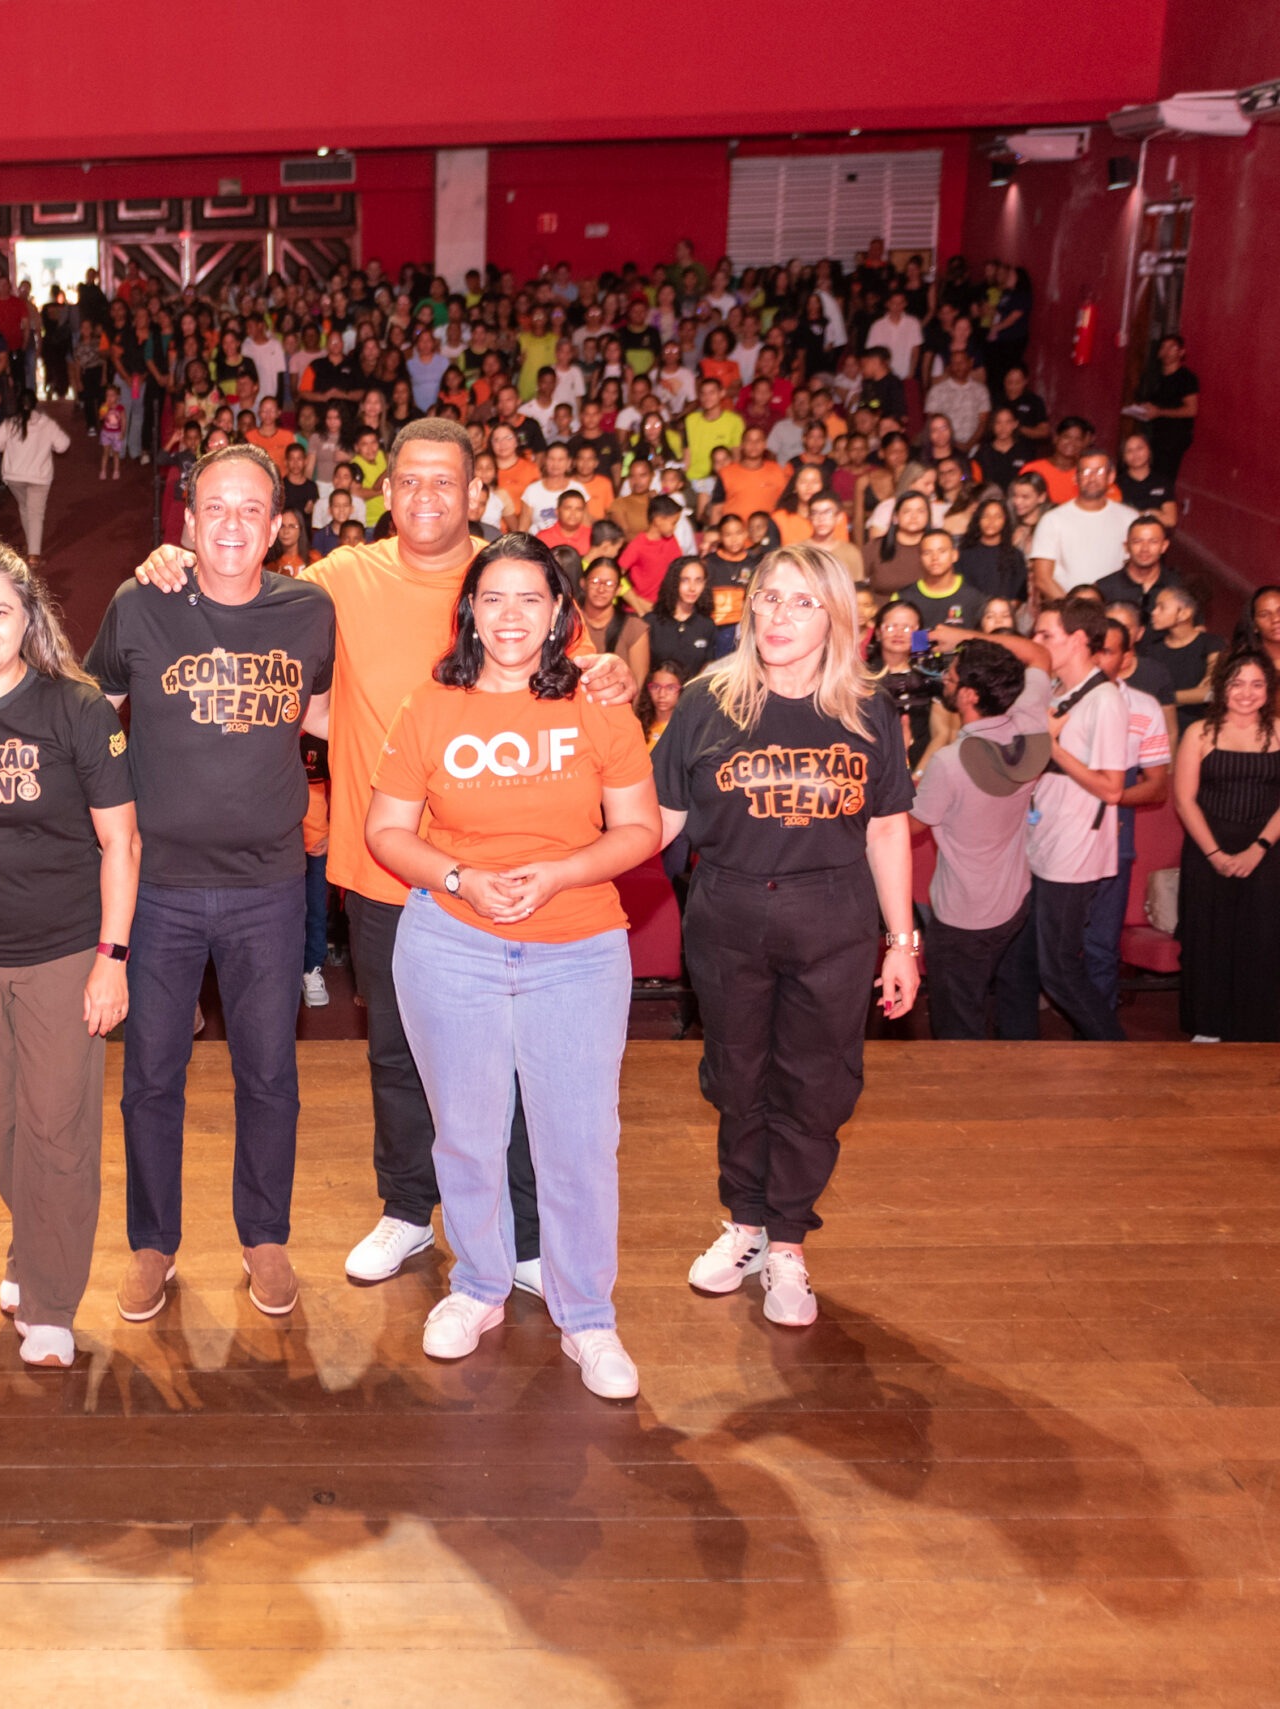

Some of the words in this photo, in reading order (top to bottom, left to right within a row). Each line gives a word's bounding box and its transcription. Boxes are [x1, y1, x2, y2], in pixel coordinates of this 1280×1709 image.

[178, 653, 299, 688] CONEXÃO
[193, 688, 279, 723] TEEN
[226, 723, 249, 733] 2026
[443, 727, 579, 779] OQJF
[732, 747, 863, 784] CONEXÃO
[457, 781, 481, 789] QUE
[490, 777, 528, 788] JESUS
[748, 784, 841, 815] TEEN
[784, 816, 810, 826] 2026
